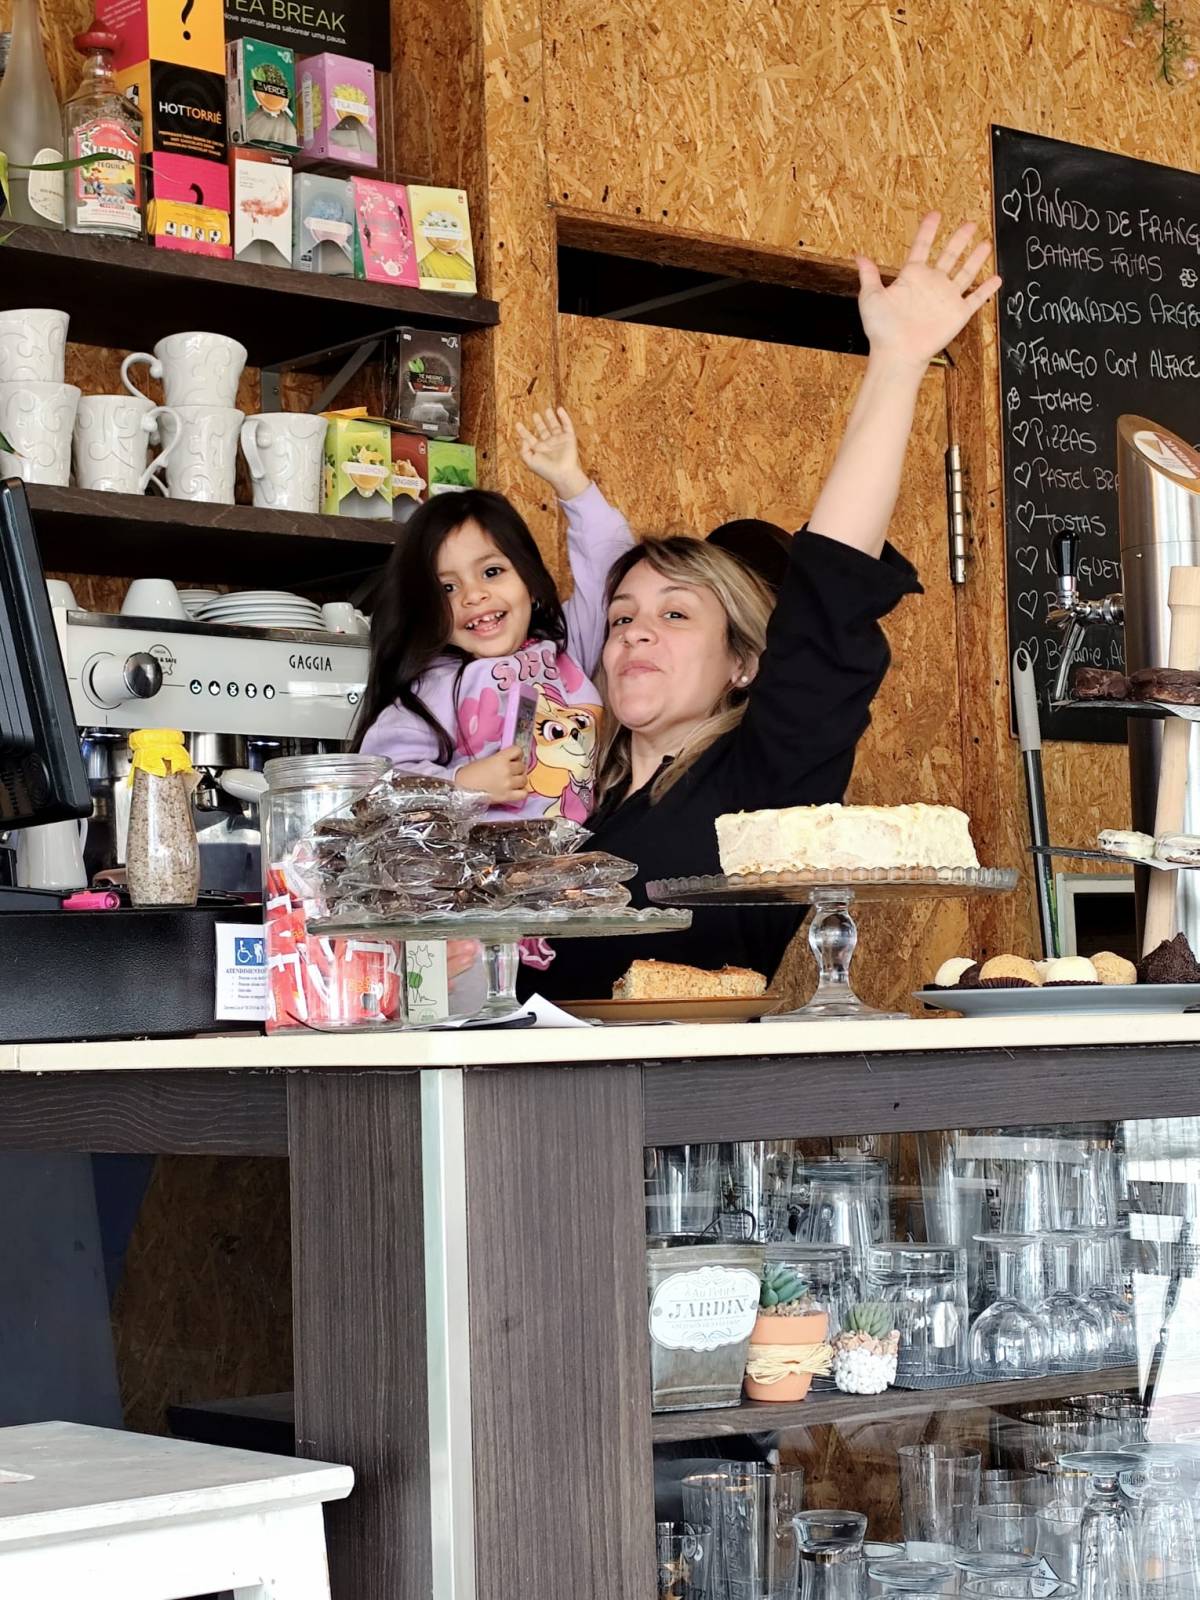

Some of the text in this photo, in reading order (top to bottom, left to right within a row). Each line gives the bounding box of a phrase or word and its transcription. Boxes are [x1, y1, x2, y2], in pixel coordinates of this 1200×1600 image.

[272, 0, 346, 33] BREAK
[265, 22, 281, 31] para
[311, 31, 326, 40] uma
[263, 83, 286, 97] VERDE
[97, 161, 126, 170] TEQUILA
[1021, 167, 1100, 231] PANADO
[1106, 210, 1132, 236] DE
[1027, 281, 1142, 325] EMPANADAS
[1028, 336, 1098, 379] FRANGO
[289, 654, 332, 672] GAGGIA
[667, 1298, 750, 1320] JARDIN
